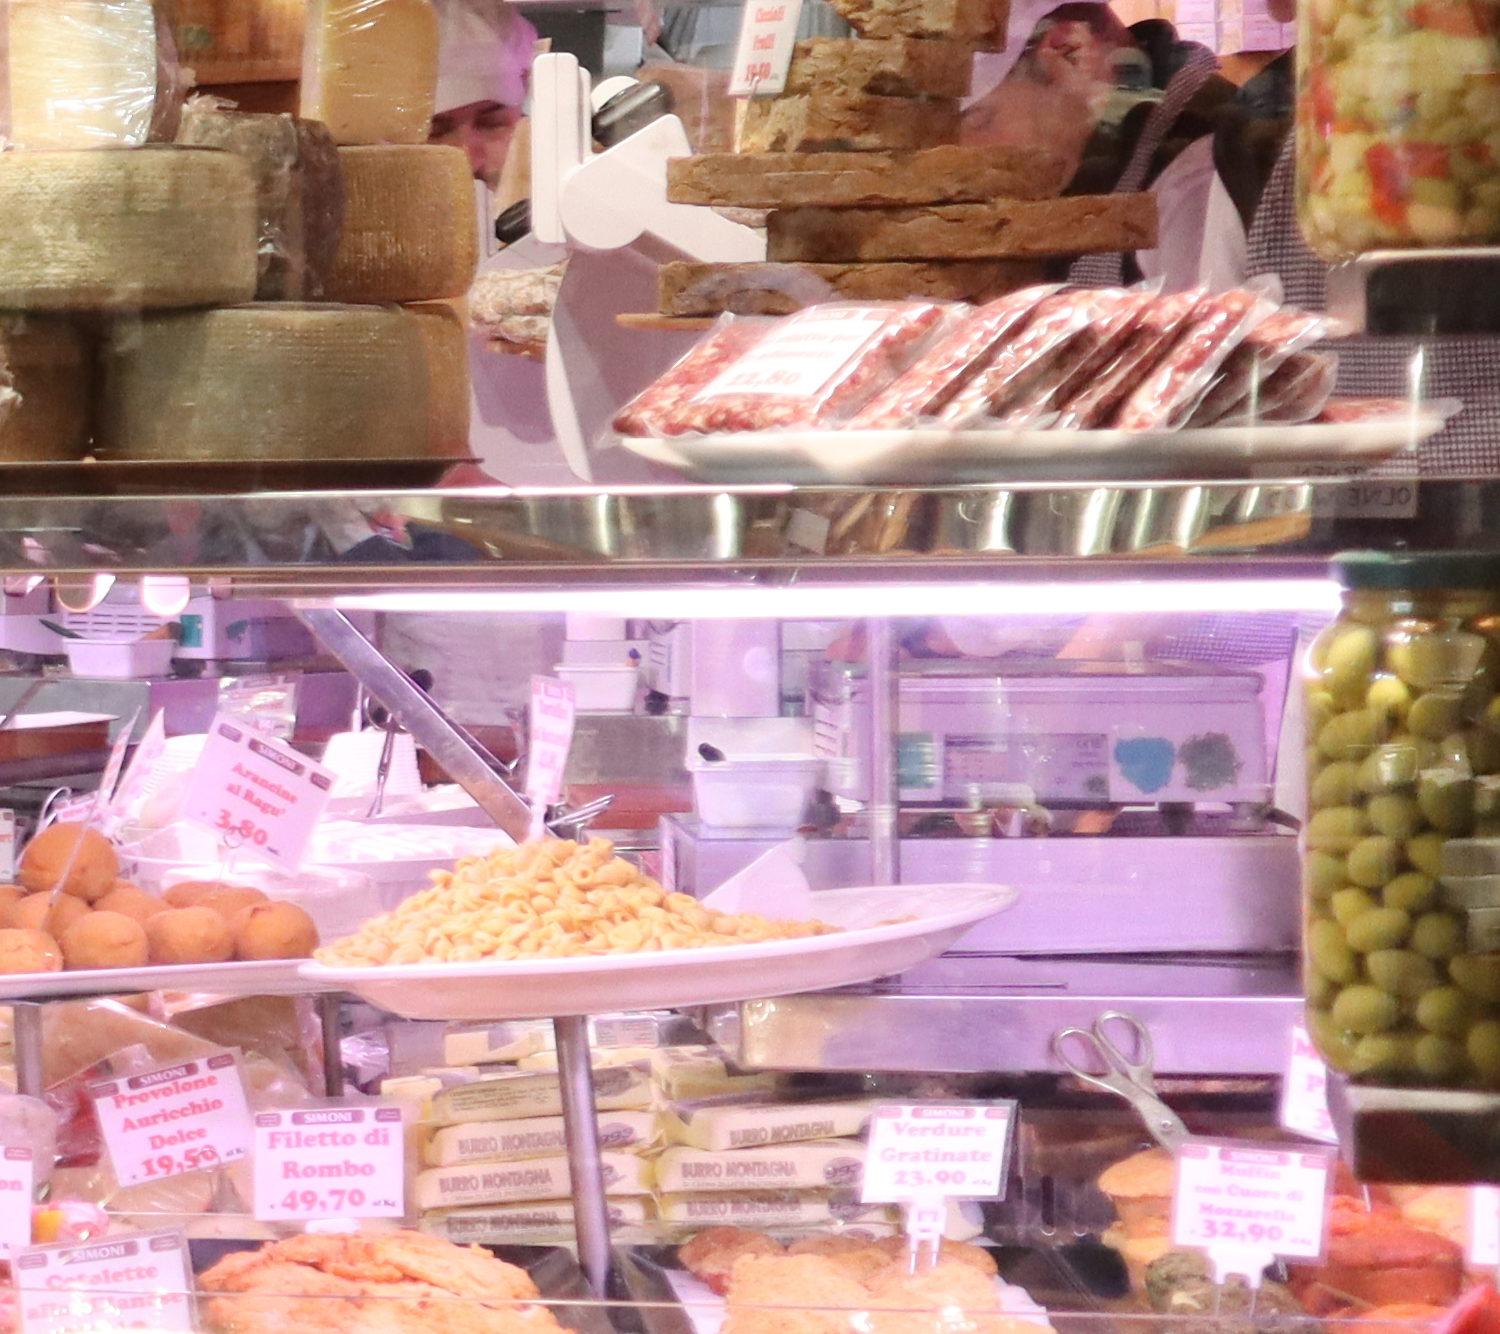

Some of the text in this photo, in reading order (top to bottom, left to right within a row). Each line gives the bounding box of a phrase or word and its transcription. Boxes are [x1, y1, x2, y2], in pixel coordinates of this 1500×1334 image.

[258, 744, 297, 770] SIMONI
[231, 762, 298, 805] Arancine
[140, 1066, 188, 1086] SIMONI
[112, 1074, 219, 1110] Provolone
[121, 1098, 224, 1134] Auricchio
[303, 1111, 354, 1125] SIMONI
[922, 1108, 966, 1119] SIMONI
[148, 1126, 208, 1151] Dolce
[268, 1128, 391, 1150] Filetto di
[730, 1123, 765, 1144] BURRO
[892, 1121, 988, 1139] Verdure
[880, 1147, 993, 1165] Gratinate
[1231, 1151, 1274, 1164] SIMONI
[281, 1160, 377, 1181] Rombo
[681, 1162, 722, 1180] BURRO
[1222, 1164, 1282, 1180] Muffin
[439, 1173, 477, 1193] BURRO
[1226, 1185, 1277, 1199] Cuore
[281, 1189, 366, 1214] 49,70
[1199, 1203, 1297, 1223] Mozzarella
[1202, 1217, 1284, 1244] 32,90
[72, 1247, 128, 1264] SIMONI
